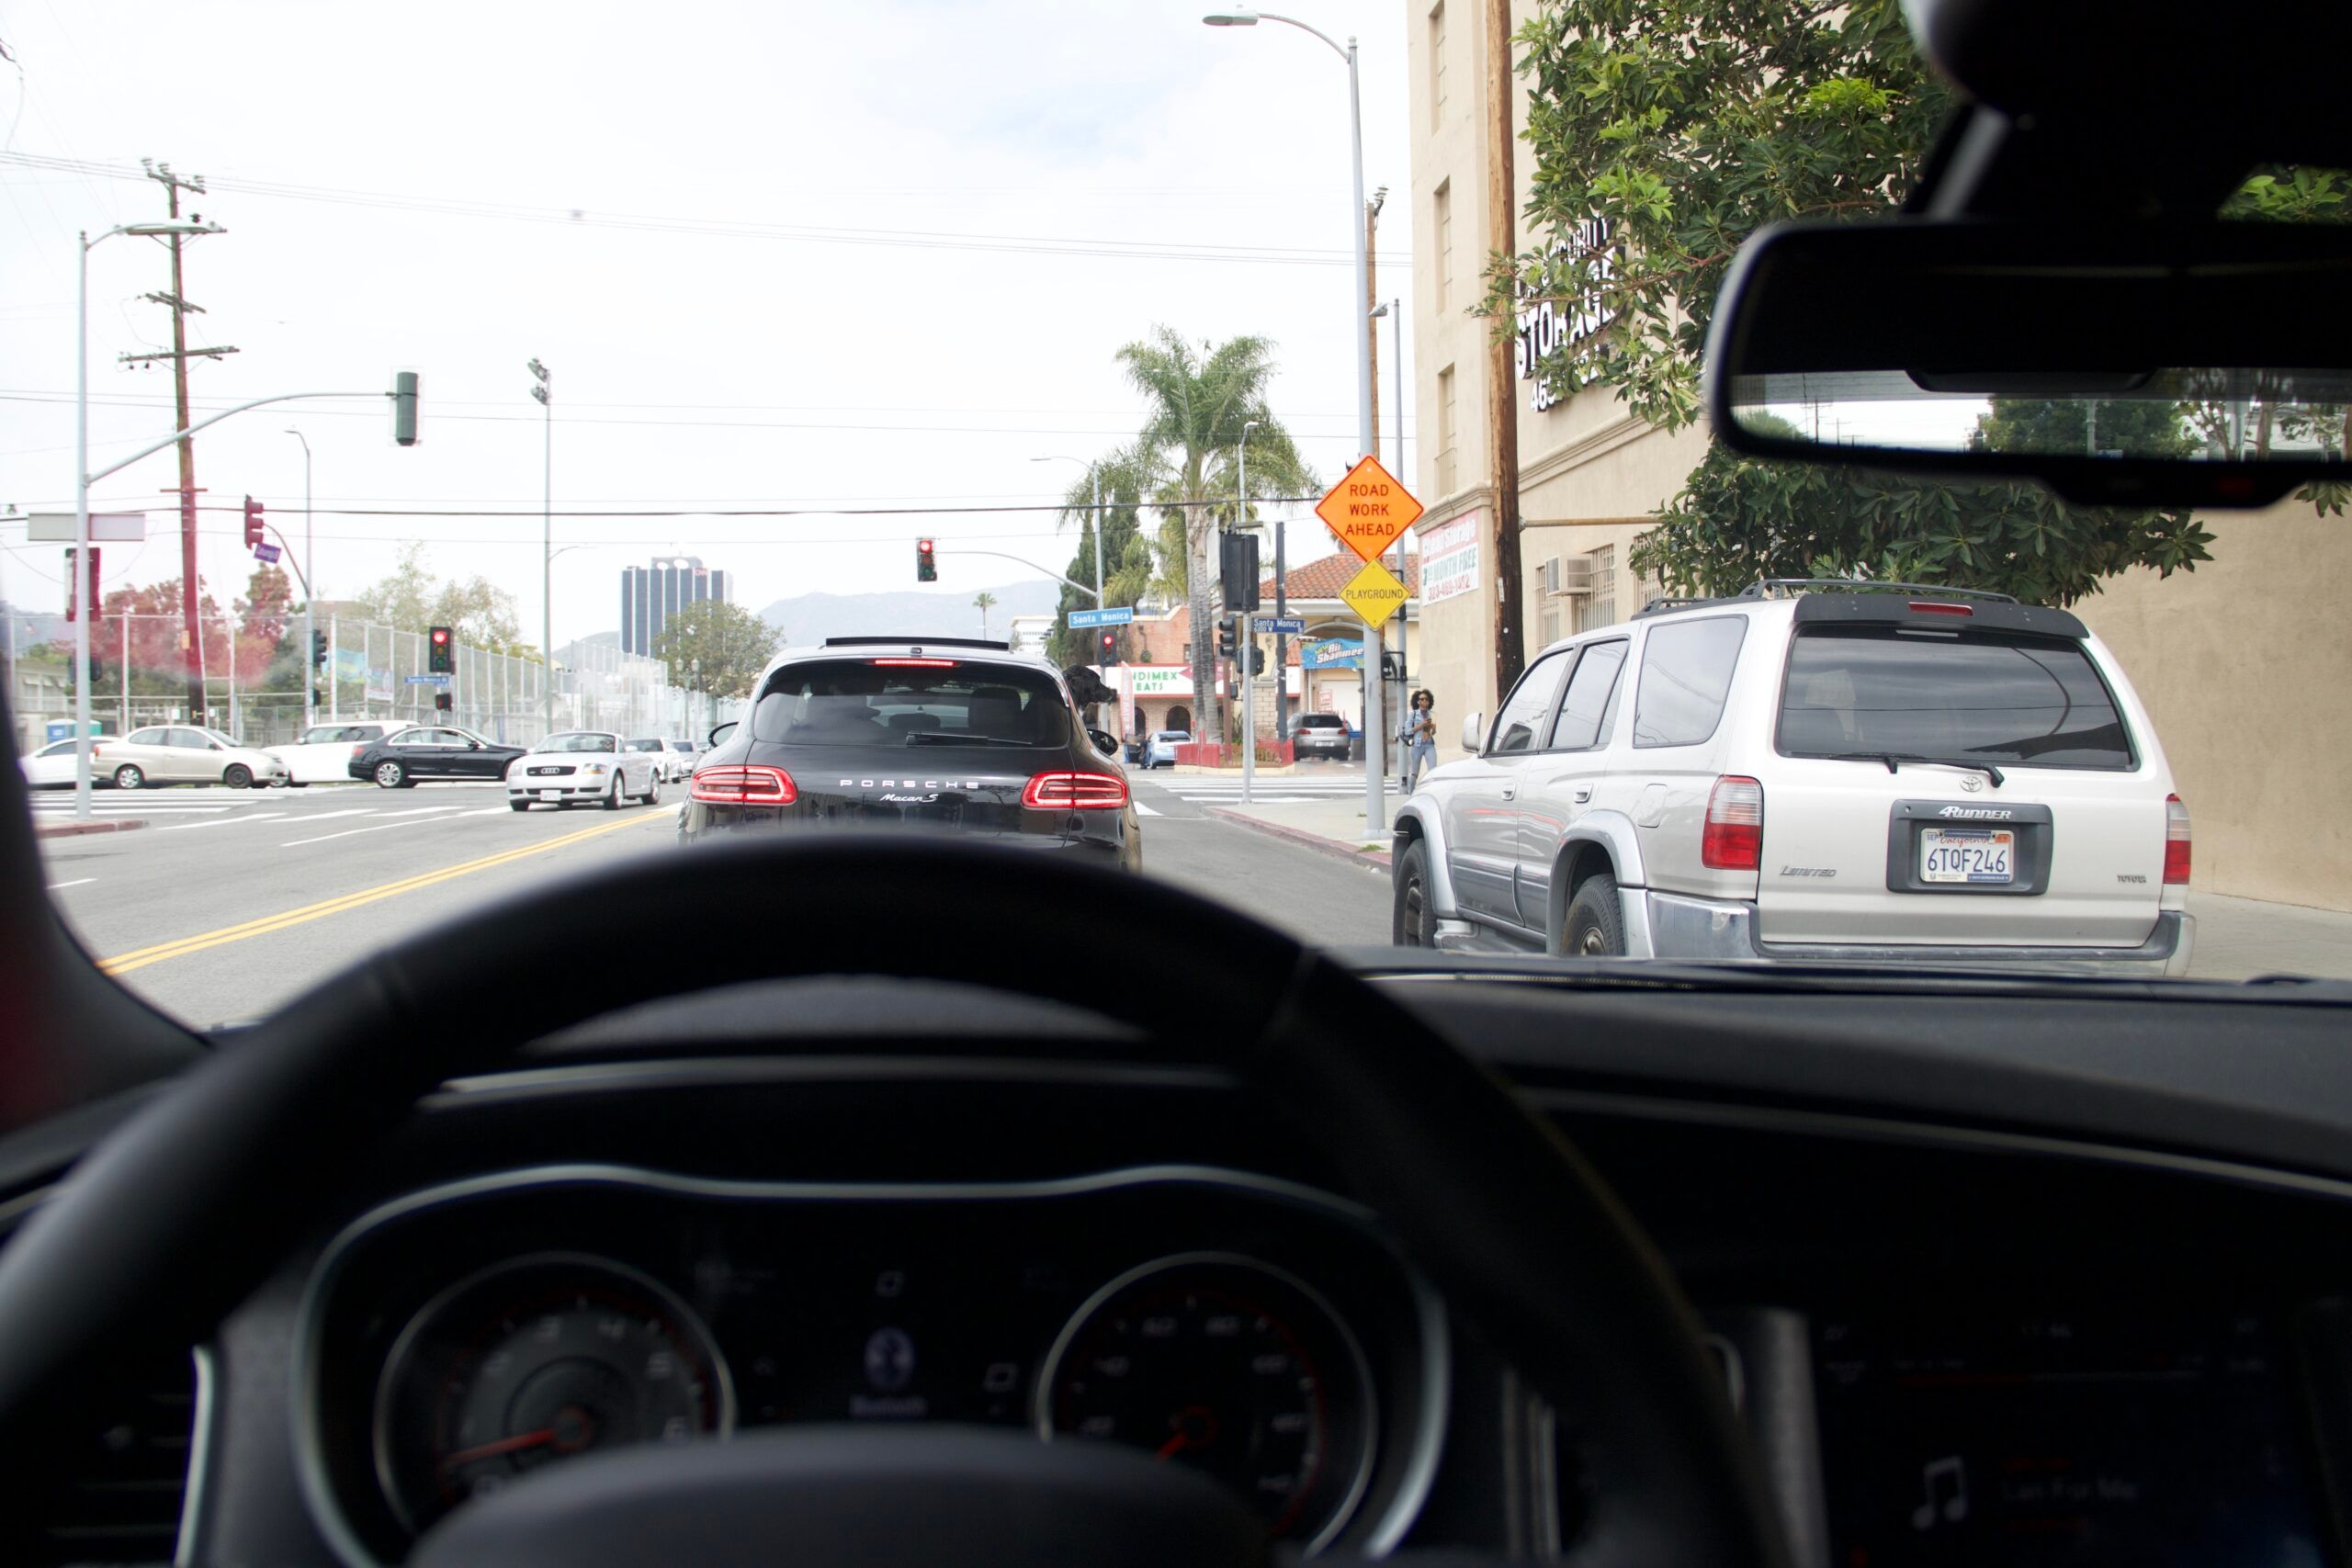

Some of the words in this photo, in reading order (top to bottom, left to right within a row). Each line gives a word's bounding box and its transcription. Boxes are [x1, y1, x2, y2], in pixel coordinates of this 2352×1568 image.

[1350, 484, 1389, 497] ROAD
[1349, 503, 1390, 516] WORK
[1345, 523, 1395, 536] AHEAD
[1345, 588, 1404, 599] PLAYGROUND
[1072, 615, 1096, 625] Santa
[1101, 612, 1129, 622] Monica
[1253, 618, 1274, 627] Santa
[1277, 618, 1301, 627] Monica
[1136, 682, 1164, 692] EATS
[840, 779, 979, 789] PORSCHE
[879, 794, 922, 802] Macan
[922, 793, 939, 803] S
[1928, 848, 2007, 873] 6TQF246
